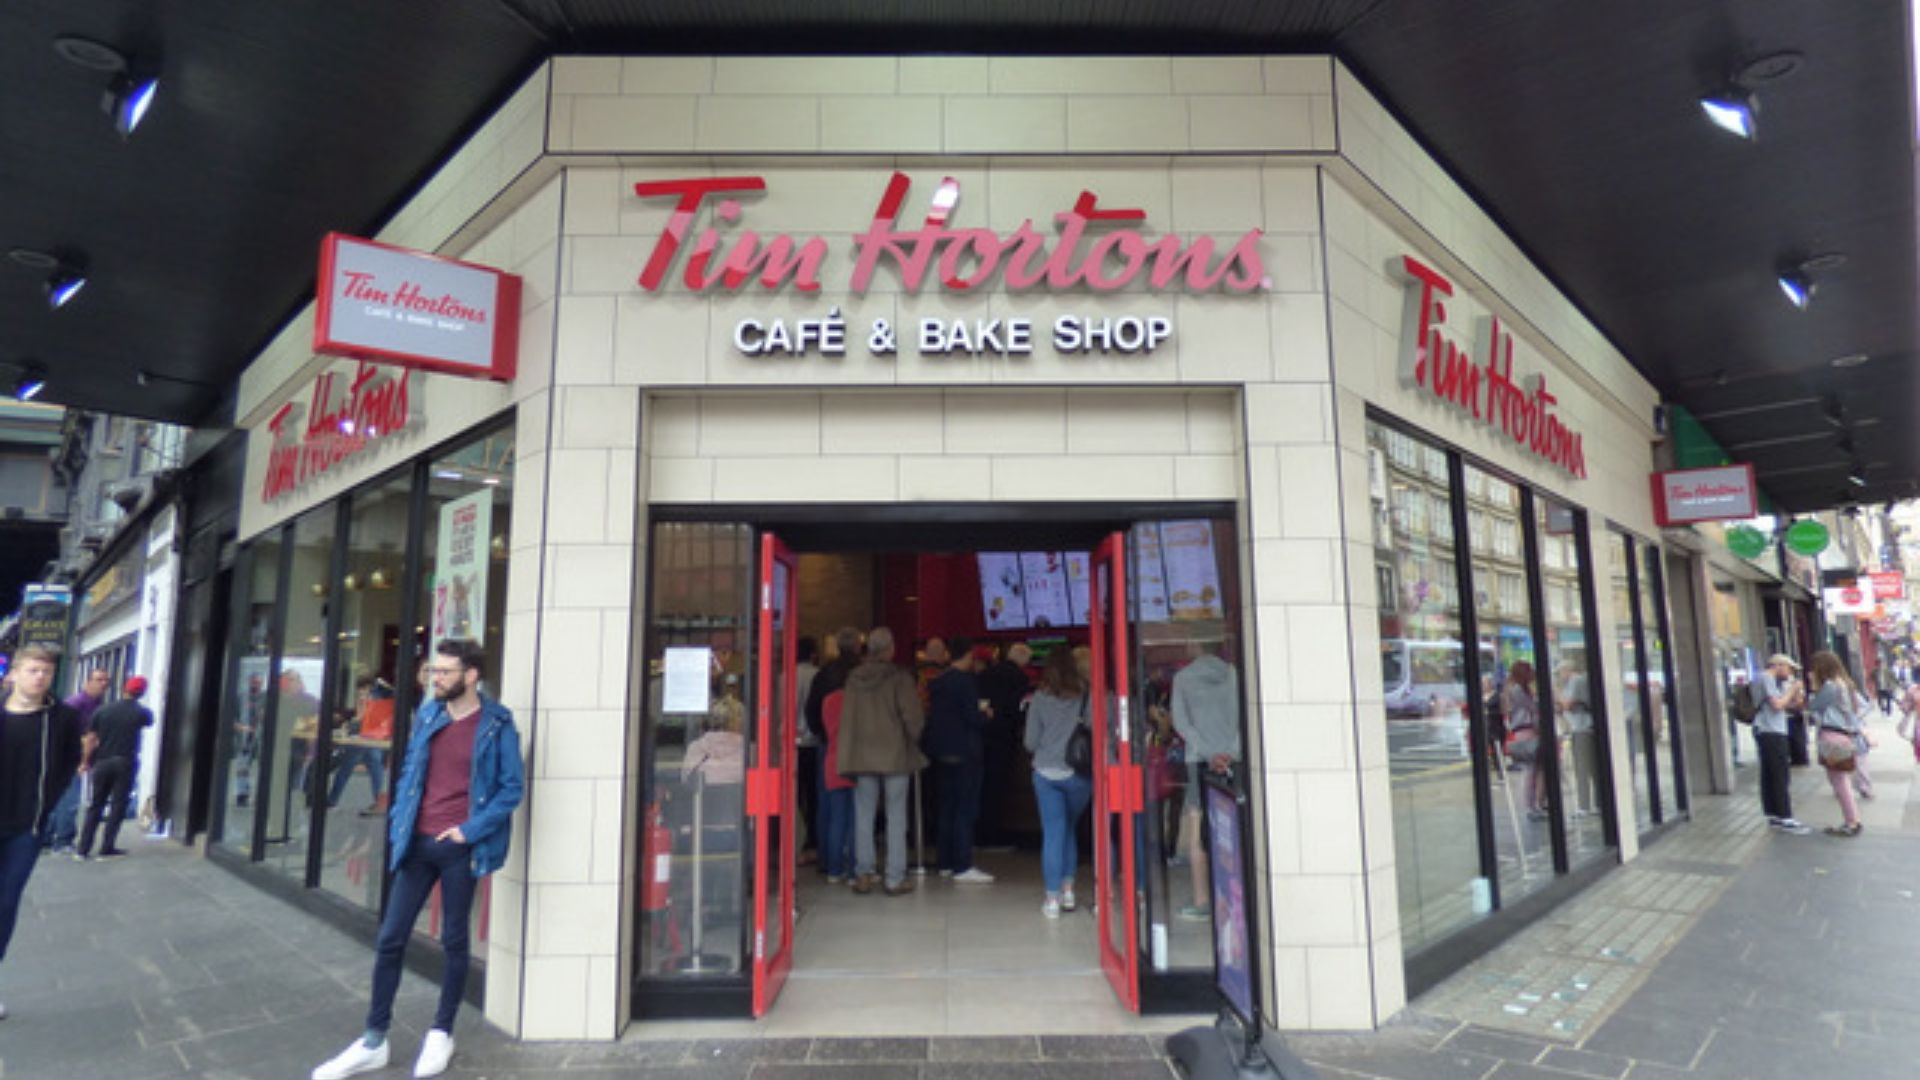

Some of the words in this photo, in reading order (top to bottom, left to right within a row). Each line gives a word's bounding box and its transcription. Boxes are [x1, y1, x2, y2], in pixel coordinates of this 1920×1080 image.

[634, 176, 828, 292] Tim
[850, 171, 1265, 292] Hortons
[342, 270, 388, 305] Tim
[393, 281, 486, 325] Hortons
[734, 304, 847, 357] CAFÉ
[867, 317, 897, 357] &
[919, 317, 1033, 356] BAKE
[1053, 315, 1173, 354] SHOP
[1404, 255, 1480, 420] Tim
[1485, 314, 1587, 480] Hortons
[262, 402, 299, 504] Tim
